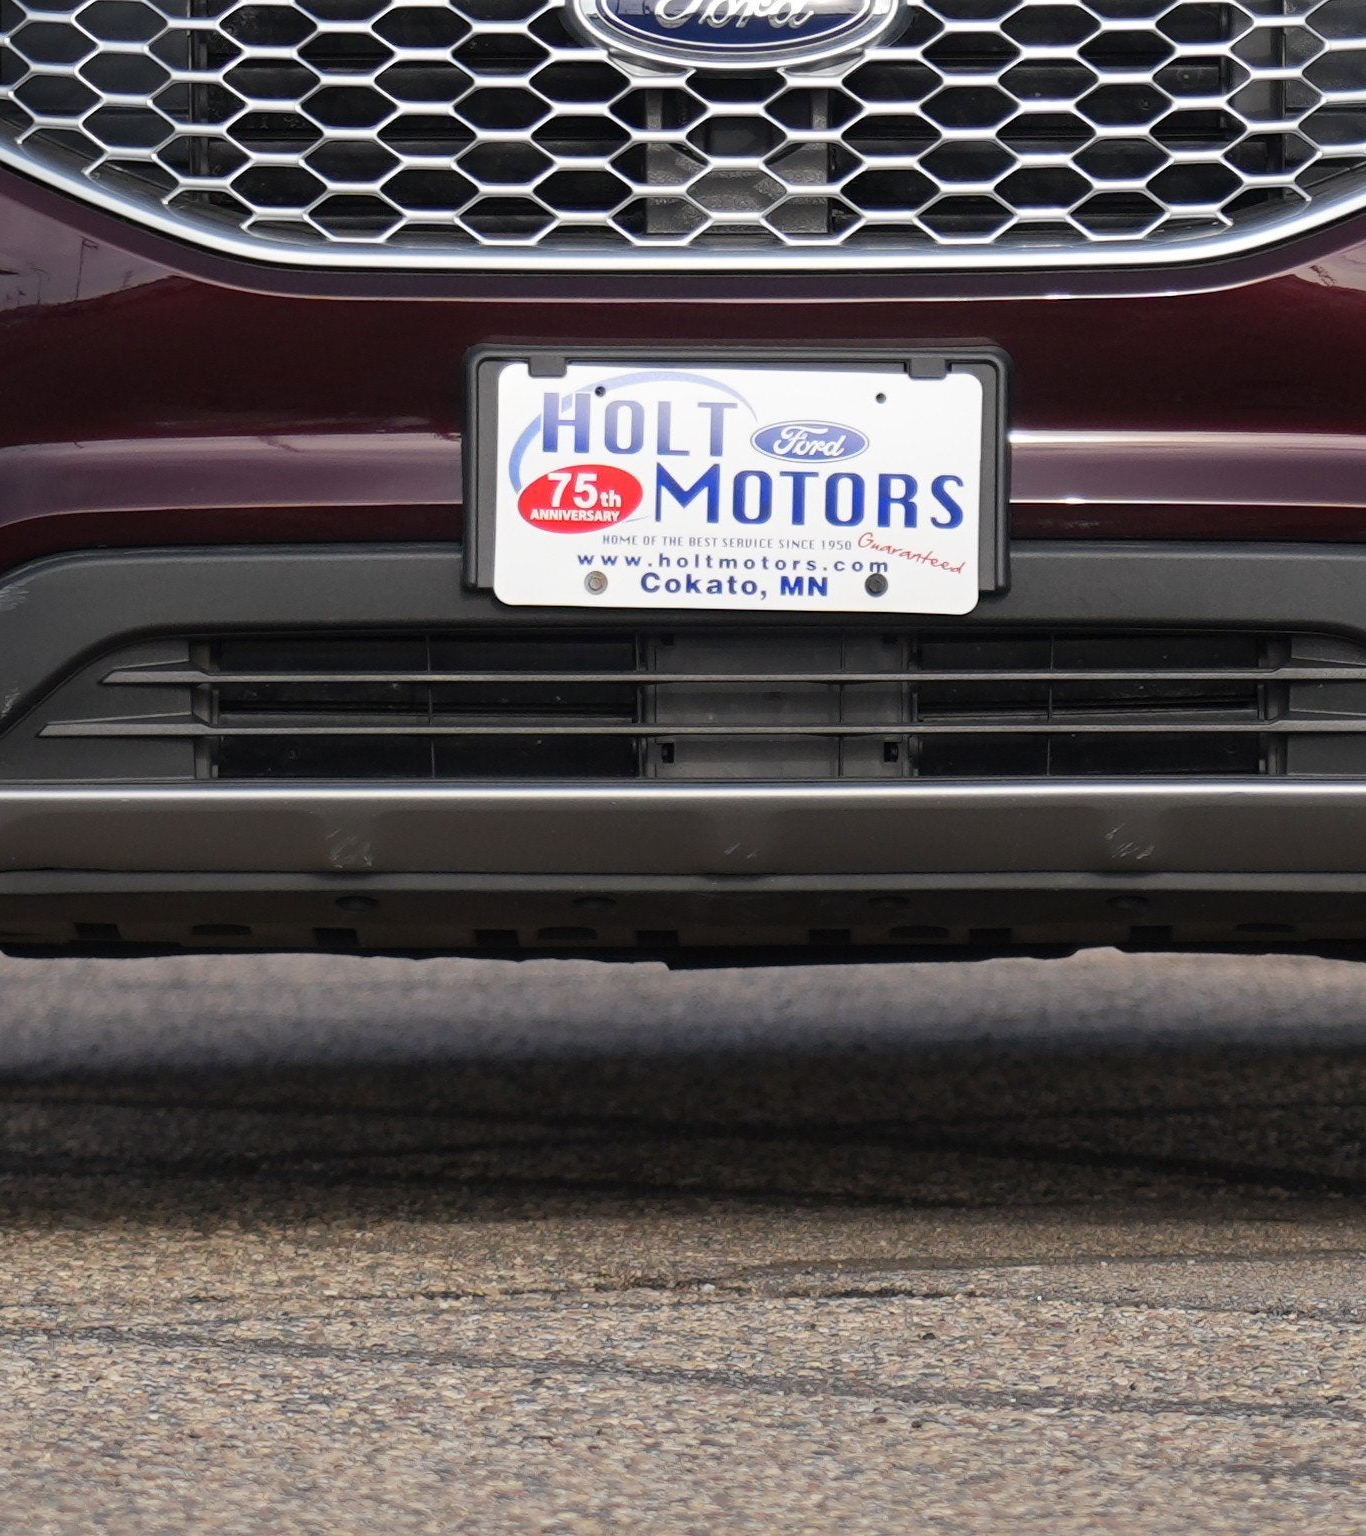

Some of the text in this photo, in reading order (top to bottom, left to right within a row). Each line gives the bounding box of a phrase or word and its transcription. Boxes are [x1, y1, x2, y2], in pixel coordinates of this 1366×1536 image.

[542, 392, 738, 457] HOLT
[772, 425, 847, 457] Ford
[547, 472, 622, 509] 75th
[654, 462, 964, 530] MOTORS
[529, 508, 621, 523] ANNIVERSARY
[602, 534, 853, 551] HOME OF THE BEST SERVICE SINCE 1950
[857, 531, 967, 575] Guaranteed
[577, 553, 889, 573] www.holtmotors.com
[640, 572, 829, 601] Cokato, MN
